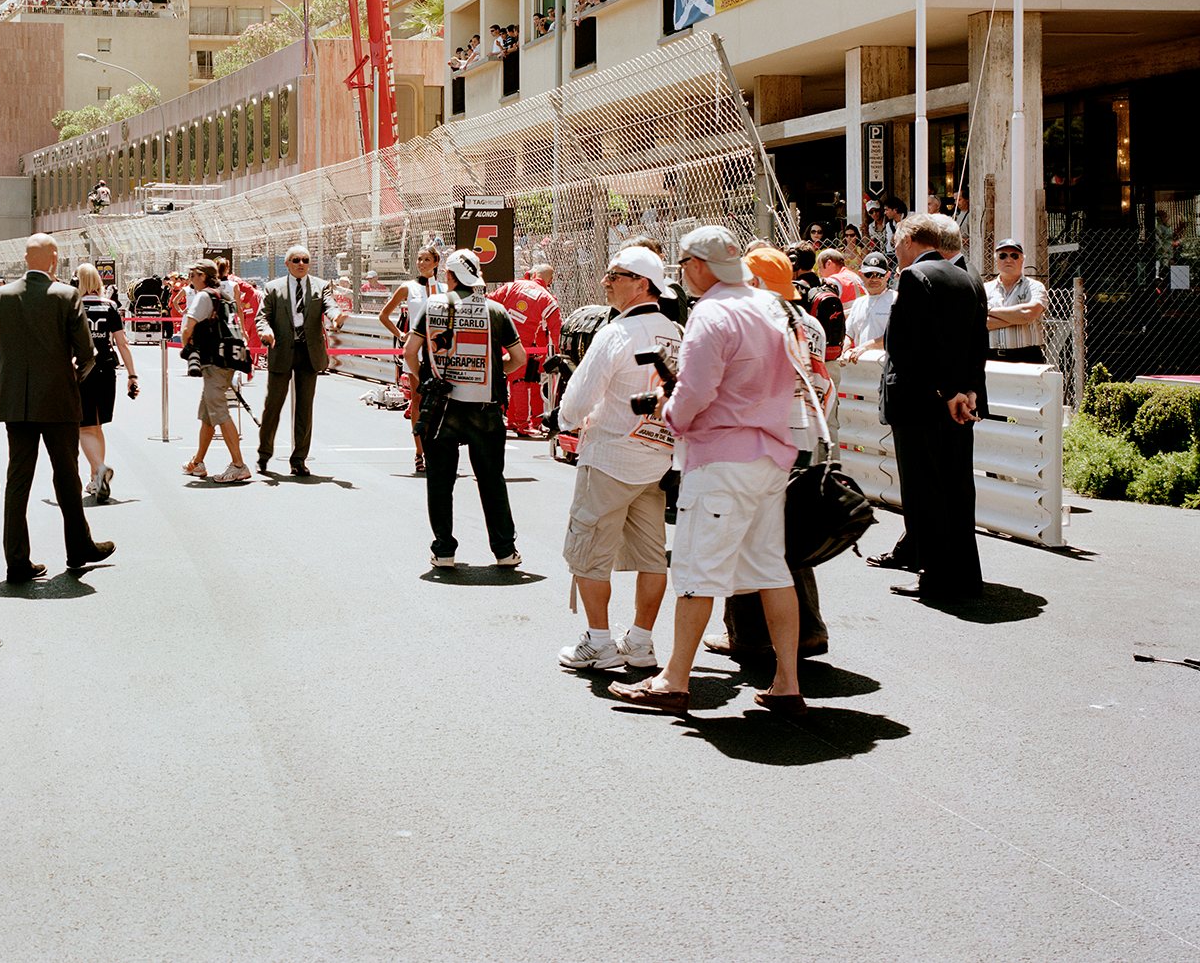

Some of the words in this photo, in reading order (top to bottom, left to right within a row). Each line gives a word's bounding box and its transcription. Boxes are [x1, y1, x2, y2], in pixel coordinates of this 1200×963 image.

[871, 127, 880, 139] P
[475, 210, 498, 218] ALONSO
[473, 224, 498, 265] 5
[429, 316, 457, 327] MONE
[459, 318, 485, 328] CARLO
